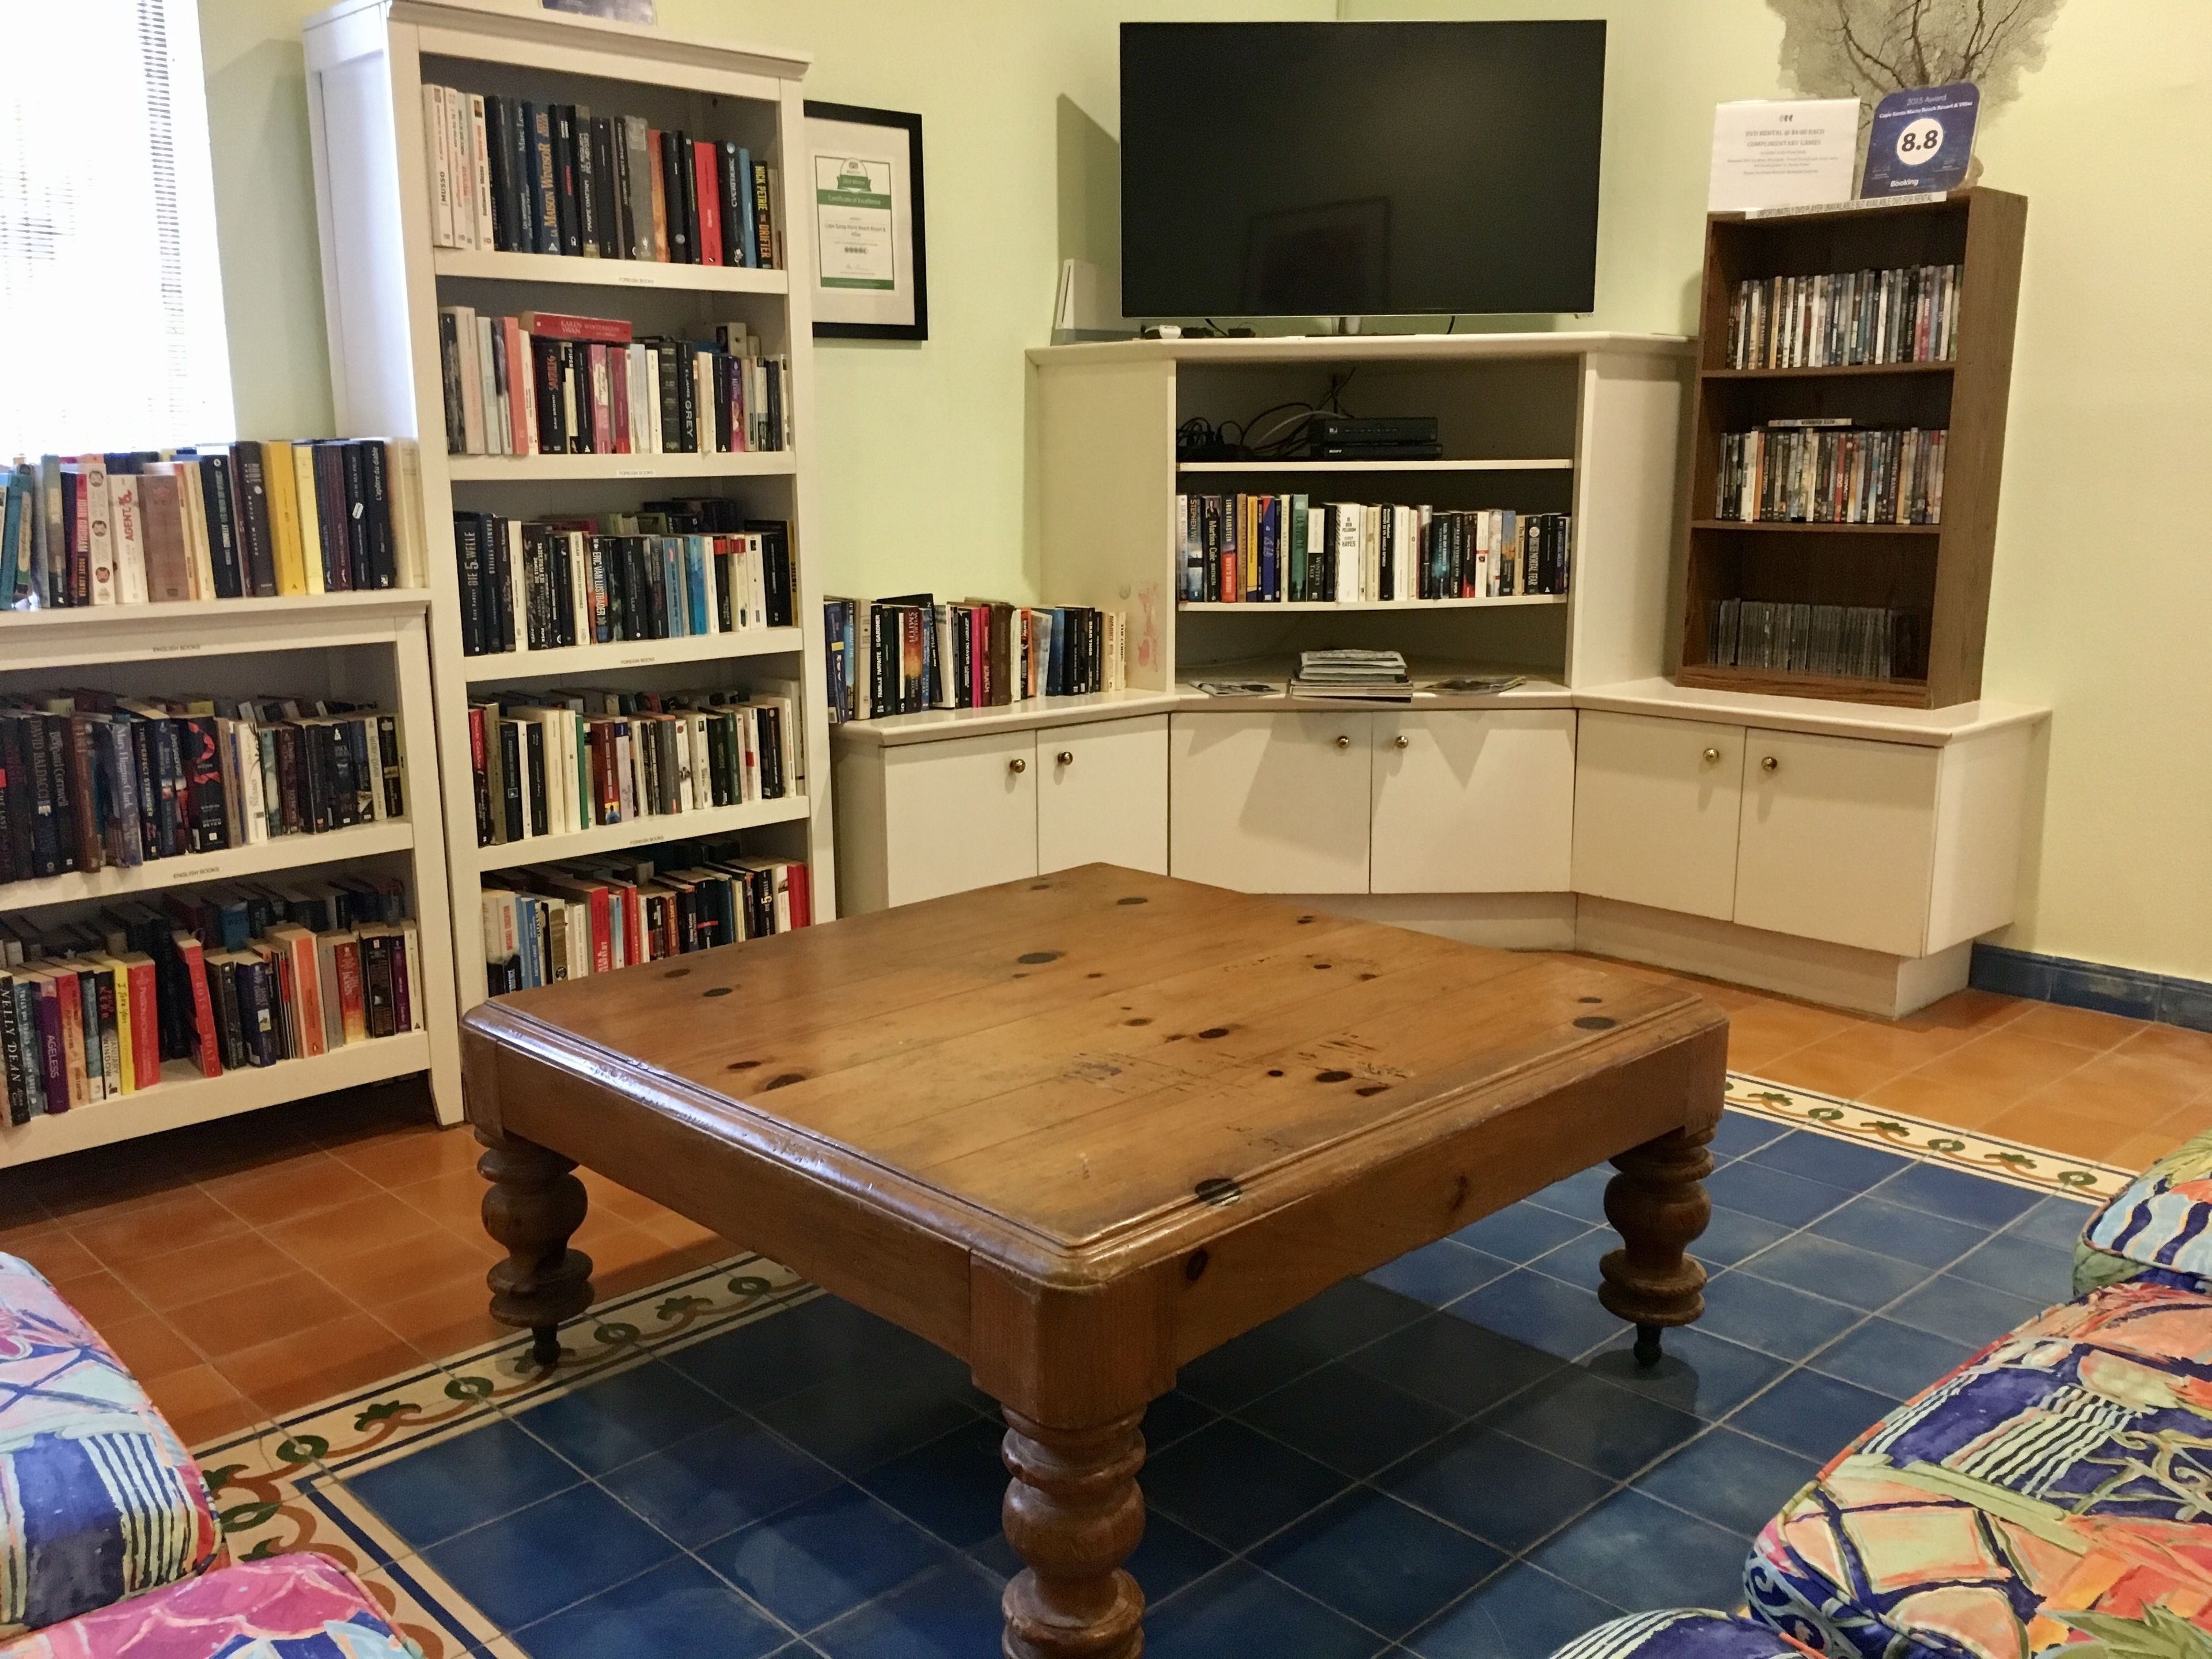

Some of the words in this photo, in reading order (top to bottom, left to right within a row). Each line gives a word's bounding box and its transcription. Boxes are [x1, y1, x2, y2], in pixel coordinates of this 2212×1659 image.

[1906, 96, 1923, 106] 2015
[1925, 94, 1947, 103] Award
[1902, 130, 1938, 152] 8.8
[538, 142, 553, 189] WINDSOR
[756, 165, 766, 184] NICK
[439, 171, 447, 203] MUSSO
[757, 185, 768, 210] PETRIE
[543, 191, 556, 228] MAISON
[1756, 207, 1795, 218] UNFORTUNATELY
[1795, 206, 1805, 215] DVD
[1805, 204, 1824, 214] PLAYER
[1824, 201, 1855, 213] UNAVAILABLE
[1855, 200, 1865, 209] BUT
[1866, 197, 1891, 207] AVAILABLE
[1891, 196, 1902, 205] DVD
[1903, 195, 1913, 204] FOR
[1914, 194, 1933, 203] RENTAL
[759, 224, 771, 258] DRIFTER
[561, 320, 582, 328] KAREN
[685, 400, 693, 438] GREY
[374, 476, 382, 501] L'apôtre
[77, 499, 87, 518] JOHN
[1296, 516, 1305, 524] LA
[77, 519, 88, 552] GRISHAM
[123, 506, 134, 541] AGENT
[1209, 520, 1217, 546] Martina
[464, 531, 476, 559] WELLE
[1296, 527, 1305, 550] SVOLTA
[593, 551, 603, 565] ERIC
[1210, 547, 1218, 561] Cole
[1528, 552, 1540, 572] MORTAL
[468, 573, 479, 586] DIE
[593, 566, 604, 579] VAN
[1528, 573, 1539, 585] FEAR
[594, 581, 605, 616] LUSTBADER
[30, 718, 44, 749] DAVID
[116, 725, 126, 751] Mary
[116, 752, 130, 785] Higgins
[141, 744, 149, 775] PERFECT
[33, 752, 49, 801] BALDACCI
[54, 768, 68, 806] Cornwell
[123, 785, 134, 809] Clark
[144, 778, 153, 817] STRANGER
[342, 971, 355, 995] JACKSON
[118, 991, 127, 1006] Take
[1, 988, 15, 1036] NELLY
[119, 1008, 128, 1024] You
[196, 982, 206, 1010] BOYS
[203, 1034, 215, 1062] BOAT
[7, 1041, 21, 1081] DEAN
[47, 1035, 59, 1078] AGELESS
[103, 1037, 111, 1077] WINDOW
[111, 1038, 119, 1074] JANUARY
